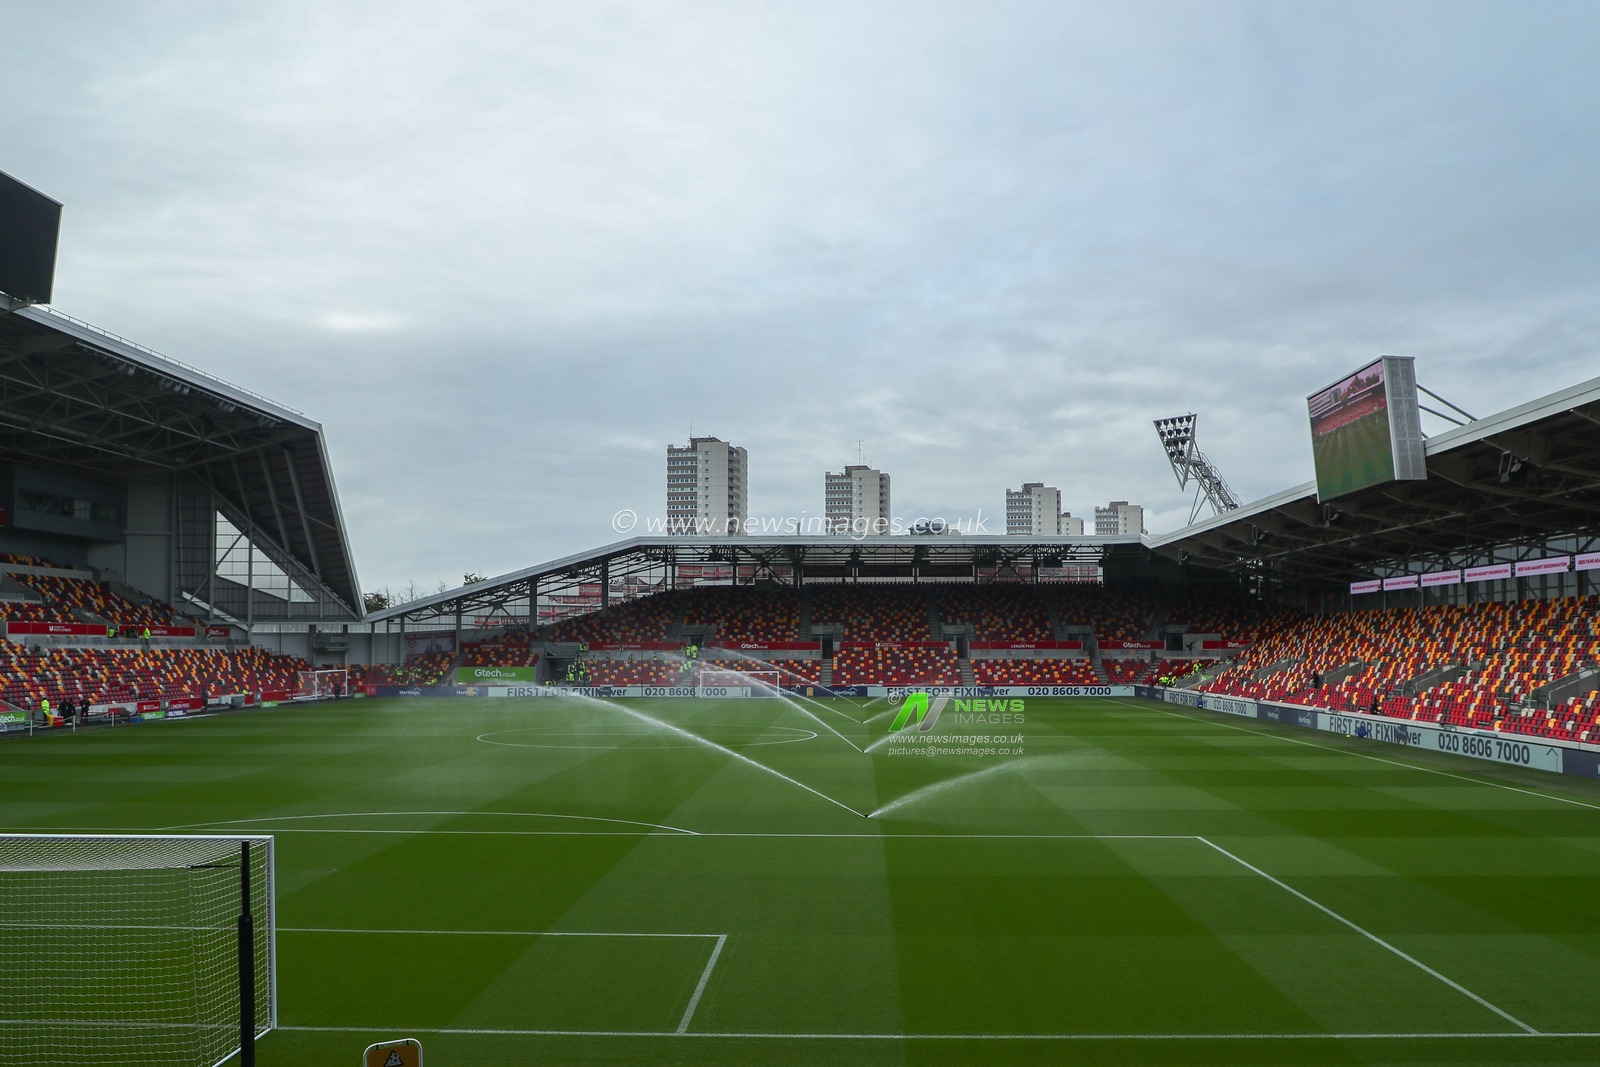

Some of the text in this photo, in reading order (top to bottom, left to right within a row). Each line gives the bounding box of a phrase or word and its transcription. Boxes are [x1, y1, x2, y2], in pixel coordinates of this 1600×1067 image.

[474, 669, 517, 678] Gtech.co.uk
[507, 687, 539, 697] FIRST
[545, 687, 569, 697] FOR
[644, 687, 728, 697] 020 8606 7000
[886, 687, 921, 697] FIRST
[924, 687, 950, 697] FOR
[1027, 687, 1112, 696] 020 8606 7000
[0, 714, 25, 723] tech.co.uk
[1329, 716, 1353, 735] FIRST
[1355, 719, 1373, 739] FOR
[1438, 732, 1531, 765] 020 8606 7000
